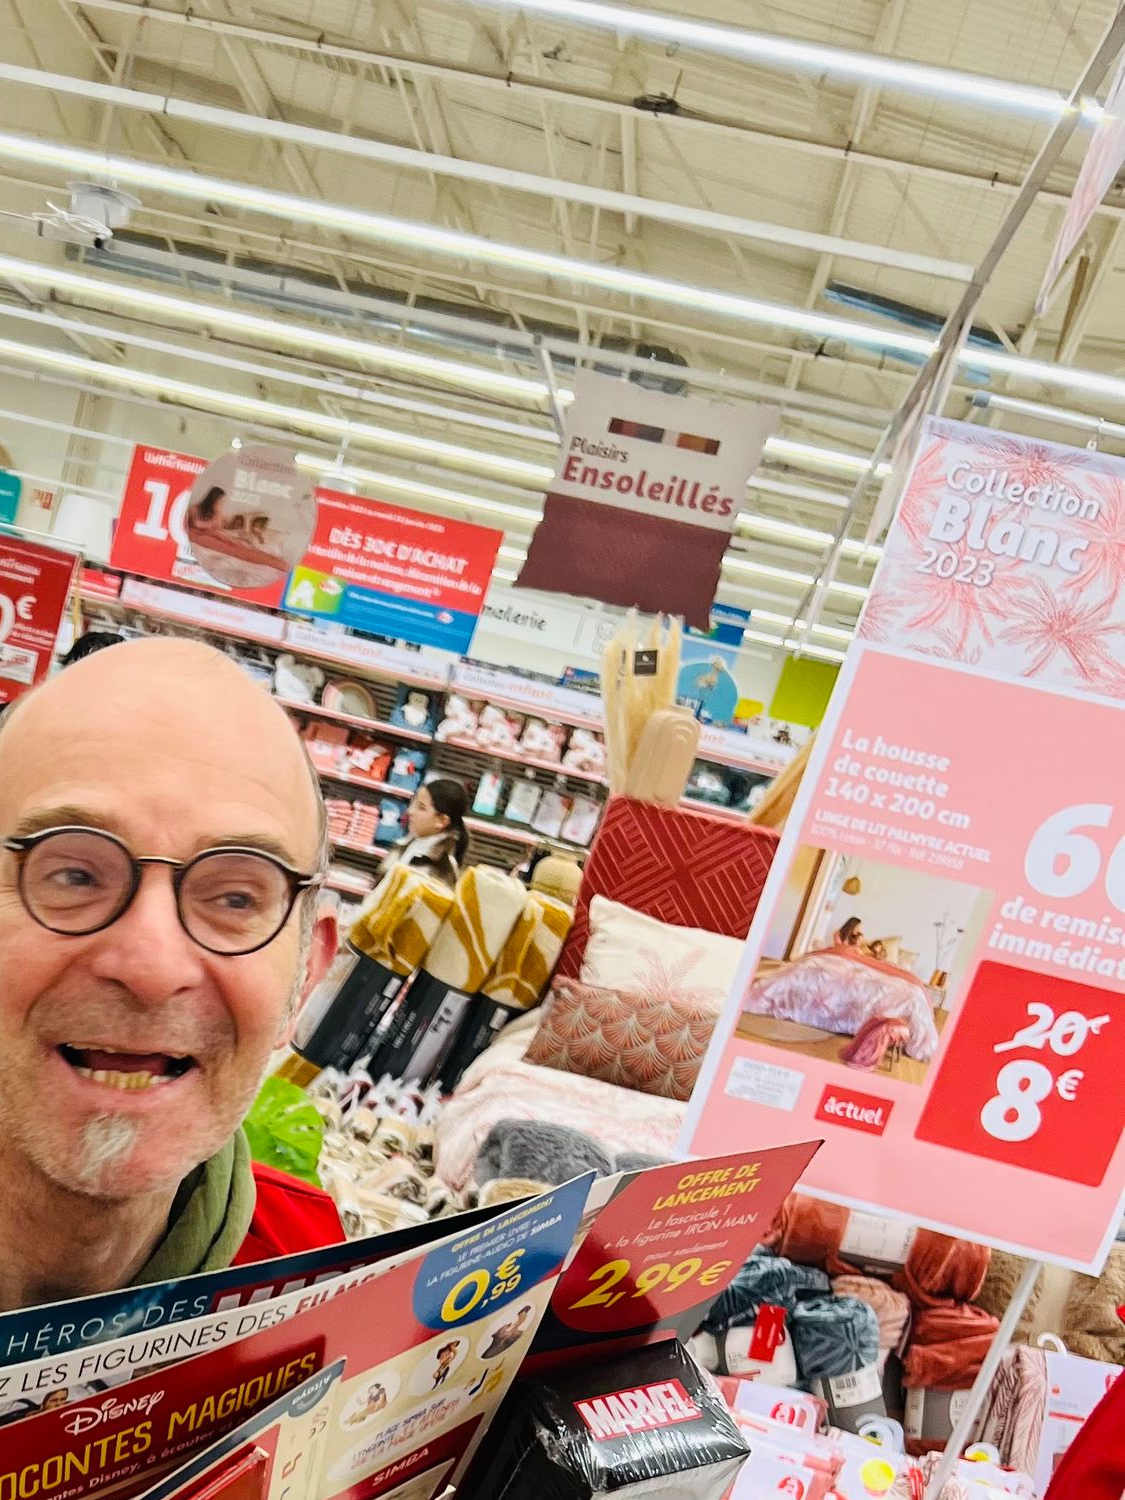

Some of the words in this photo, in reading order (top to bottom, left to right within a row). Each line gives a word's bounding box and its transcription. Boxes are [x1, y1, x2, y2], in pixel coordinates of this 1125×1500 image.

[569, 437, 629, 463] Plaisirs
[560, 456, 733, 518] Ensoleillés
[946, 462, 1101, 521] Collection
[928, 494, 1090, 573] Blanc
[915, 546, 996, 588] 2023
[841, 729, 868, 752] La
[873, 736, 951, 772] housse
[833, 754, 860, 777] de
[864, 763, 949, 798] couette
[825, 777, 870, 804] 140
[870, 792, 884, 808] x
[887, 793, 936, 821] 200
[937, 809, 971, 830] cm
[1000, 896, 1038, 925] de
[652, 1178, 763, 1211] LANCEMENT
[678, 1167, 735, 1191] OFFRE
[734, 1163, 762, 1180] DE
[529, 1213, 563, 1237] SIMBA
[633, 1228, 683, 1247] figurine
[685, 1220, 722, 1236] IRON
[723, 1212, 759, 1228] MAN
[647, 1218, 661, 1231] Le
[666, 1208, 720, 1227] fascicule
[141, 1296, 209, 1331] DES
[21, 1363, 69, 1393] LES
[77, 1321, 229, 1373] FIGURINES
[235, 1301, 289, 1340] DES
[60, 1389, 165, 1437] Disney
[168, 1351, 318, 1442] MAGIQUES
[577, 1380, 701, 1440] MARVEL
[88, 1461, 143, 1492] Disney,
[161, 1429, 214, 1458] écouter
[372, 1447, 430, 1487] SIMBA
